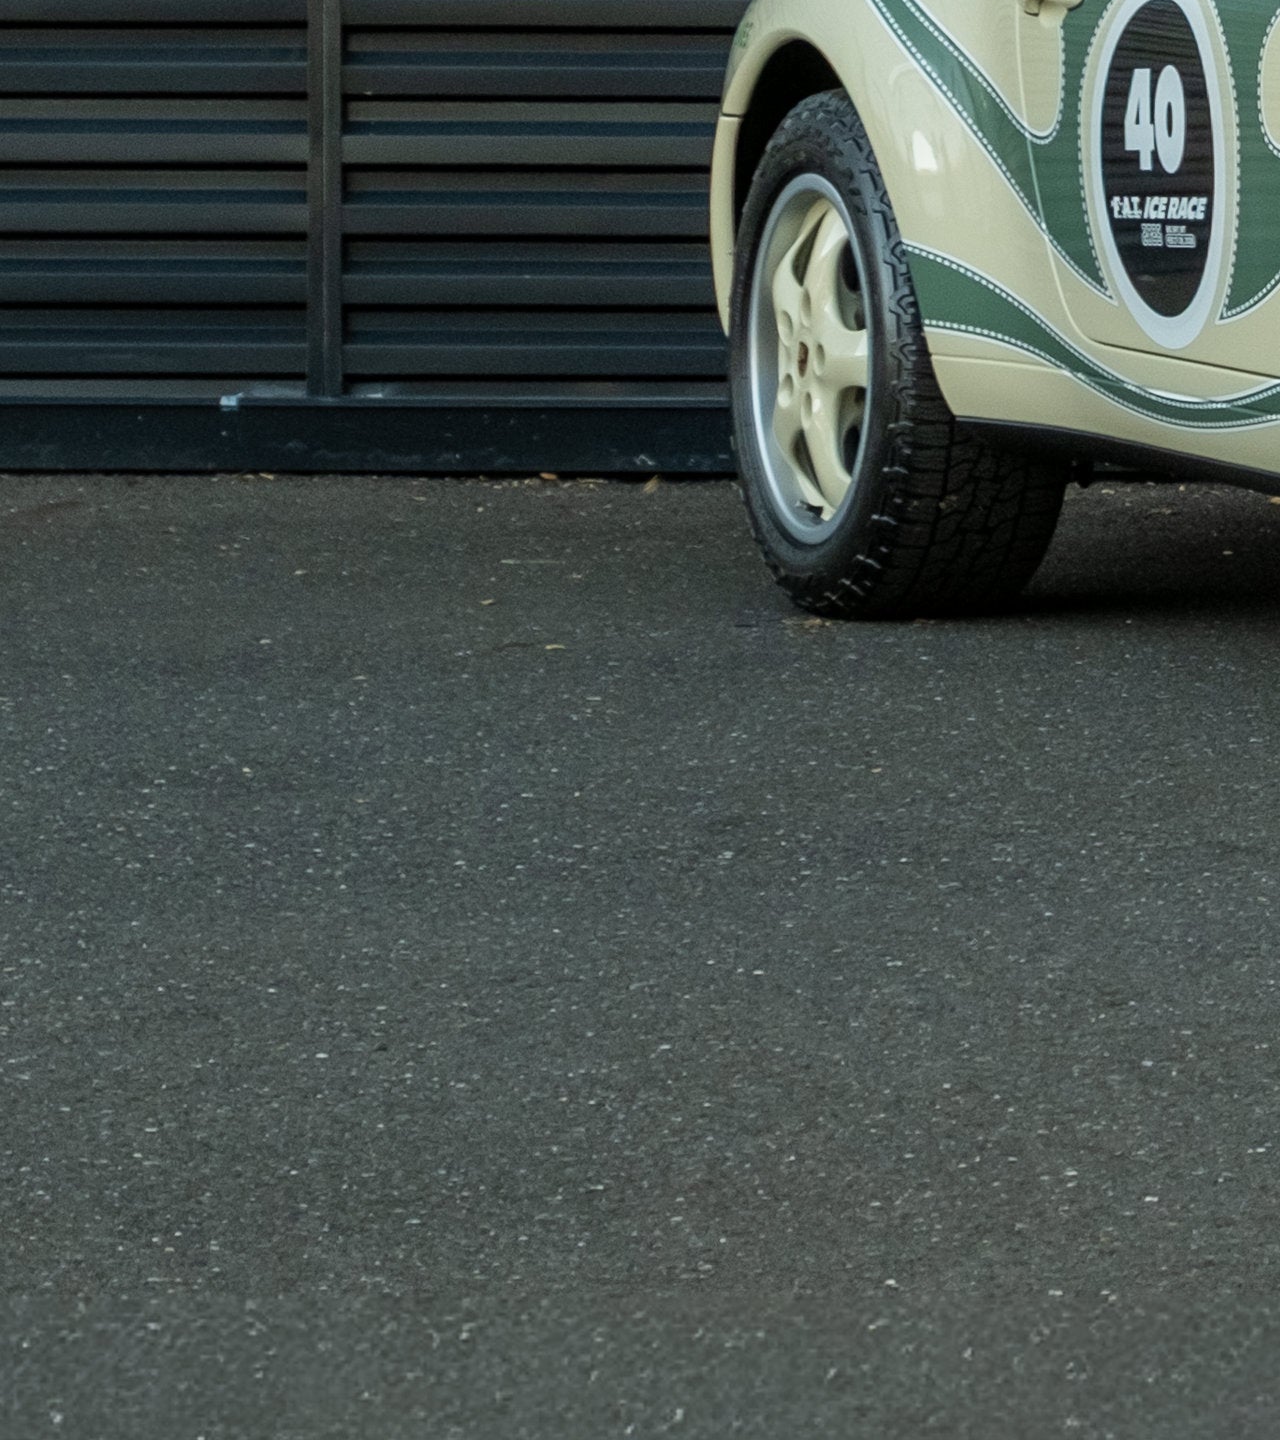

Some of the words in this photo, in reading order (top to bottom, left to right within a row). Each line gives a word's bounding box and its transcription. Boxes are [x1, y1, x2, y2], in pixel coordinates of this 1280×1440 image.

[1124, 65, 1186, 174] 40
[1143, 196, 1168, 220] ICE
[1167, 196, 1208, 220] RACE
